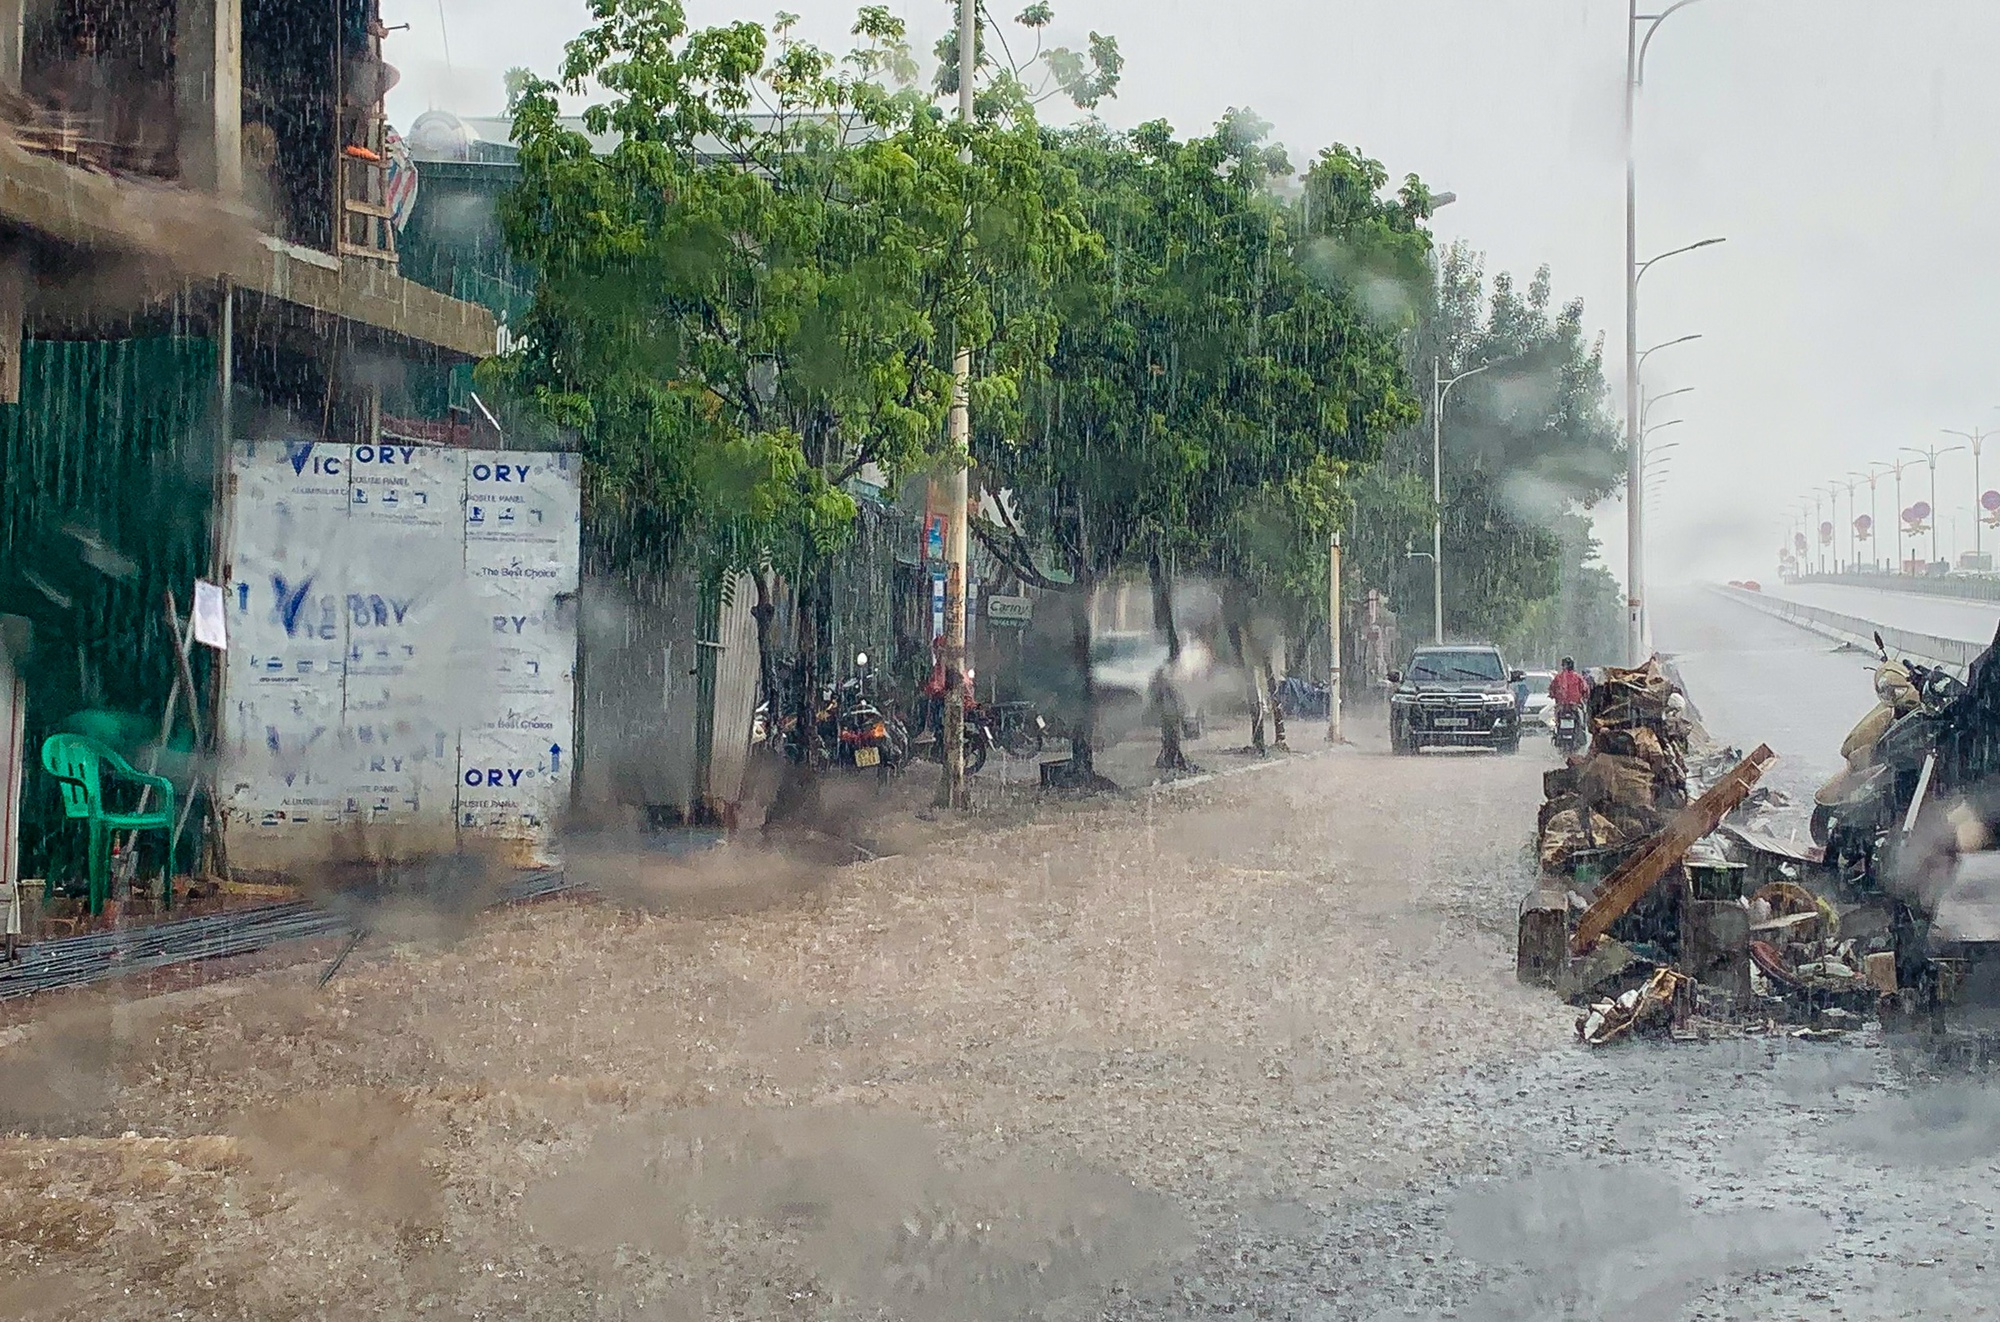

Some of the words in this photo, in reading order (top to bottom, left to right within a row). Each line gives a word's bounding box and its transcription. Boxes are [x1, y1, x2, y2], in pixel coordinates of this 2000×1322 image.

[356, 446, 415, 464] ORY
[473, 464, 531, 483] ORY
[482, 567, 499, 576] The
[501, 567, 522, 577] Best
[524, 568, 556, 579] Choice
[464, 768, 524, 787] ORY
